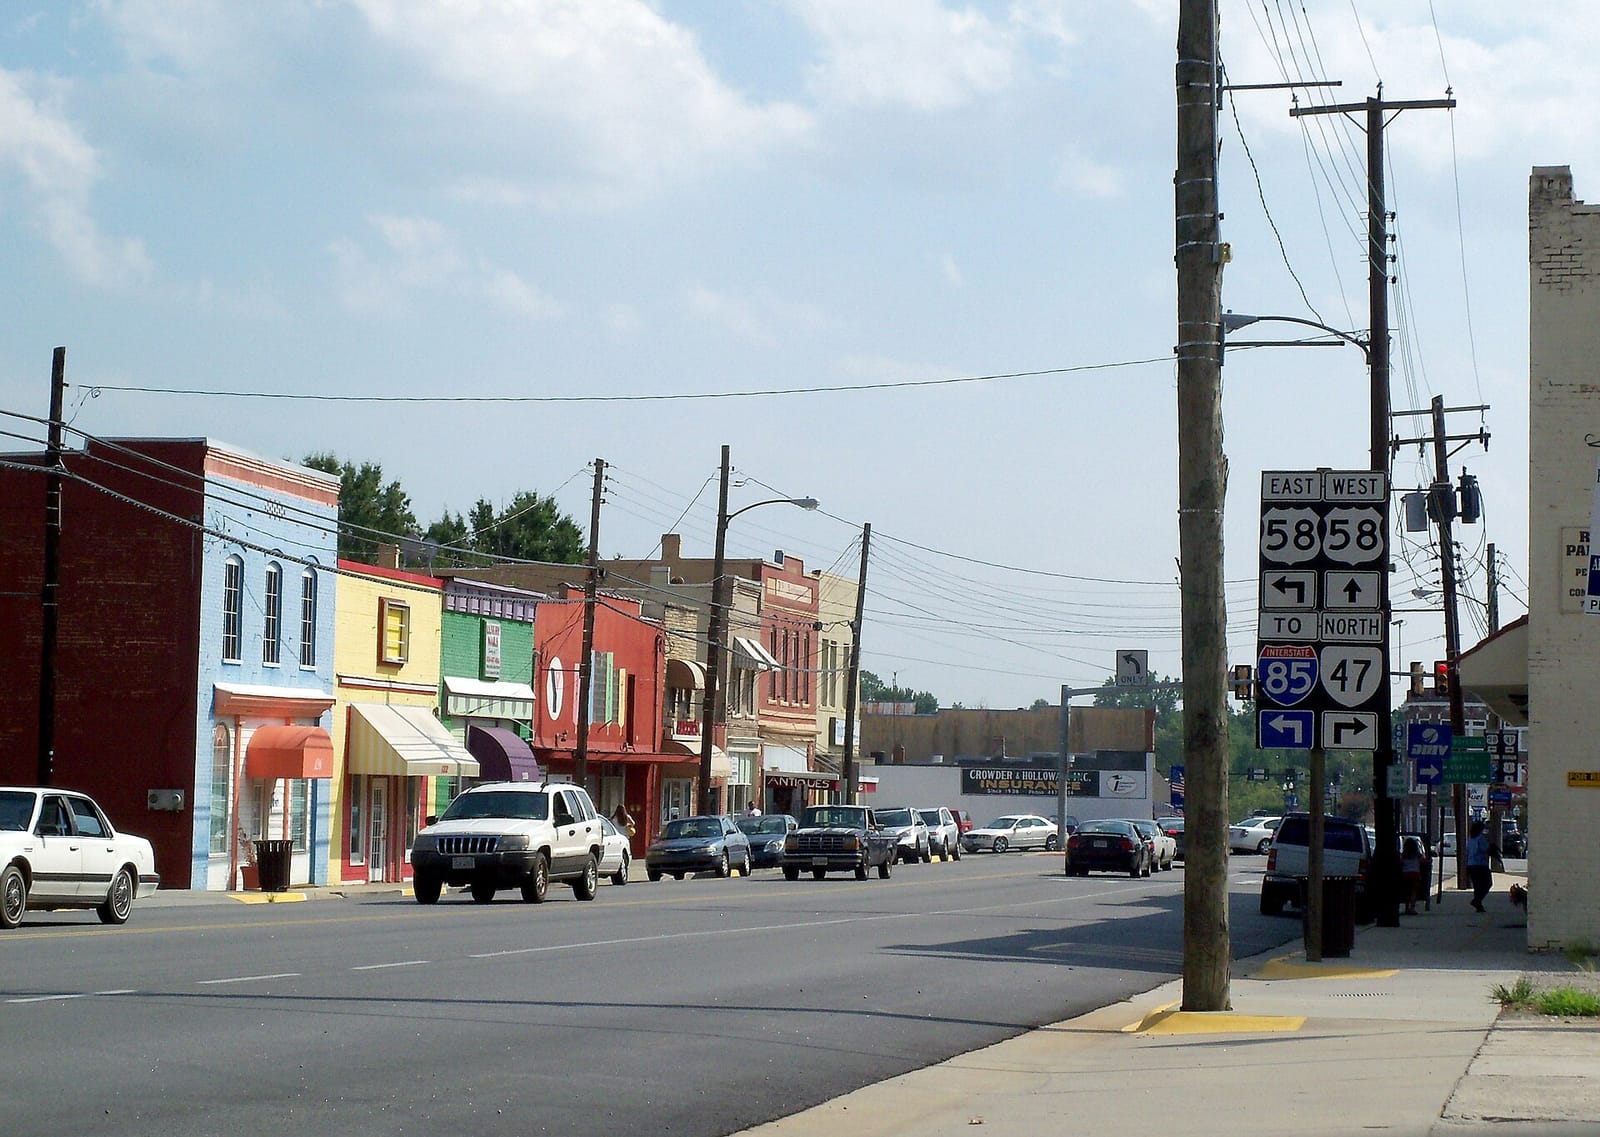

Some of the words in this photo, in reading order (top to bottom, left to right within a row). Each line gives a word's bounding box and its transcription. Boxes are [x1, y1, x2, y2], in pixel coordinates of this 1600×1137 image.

[1271, 478, 1313, 495] EAST
[1333, 478, 1378, 495] WEST
[1266, 519, 1315, 551] 58
[1328, 519, 1378, 551] 58
[1274, 617, 1302, 634] TO
[1324, 618, 1379, 635] NORTH
[1266, 648, 1310, 657] INTERSTATE
[1120, 675, 1144, 684] ONLY
[1265, 661, 1312, 695] 85
[1330, 659, 1372, 693] 47
[767, 776, 830, 789] ANTIQUES
[969, 769, 1013, 780] CROWDER
